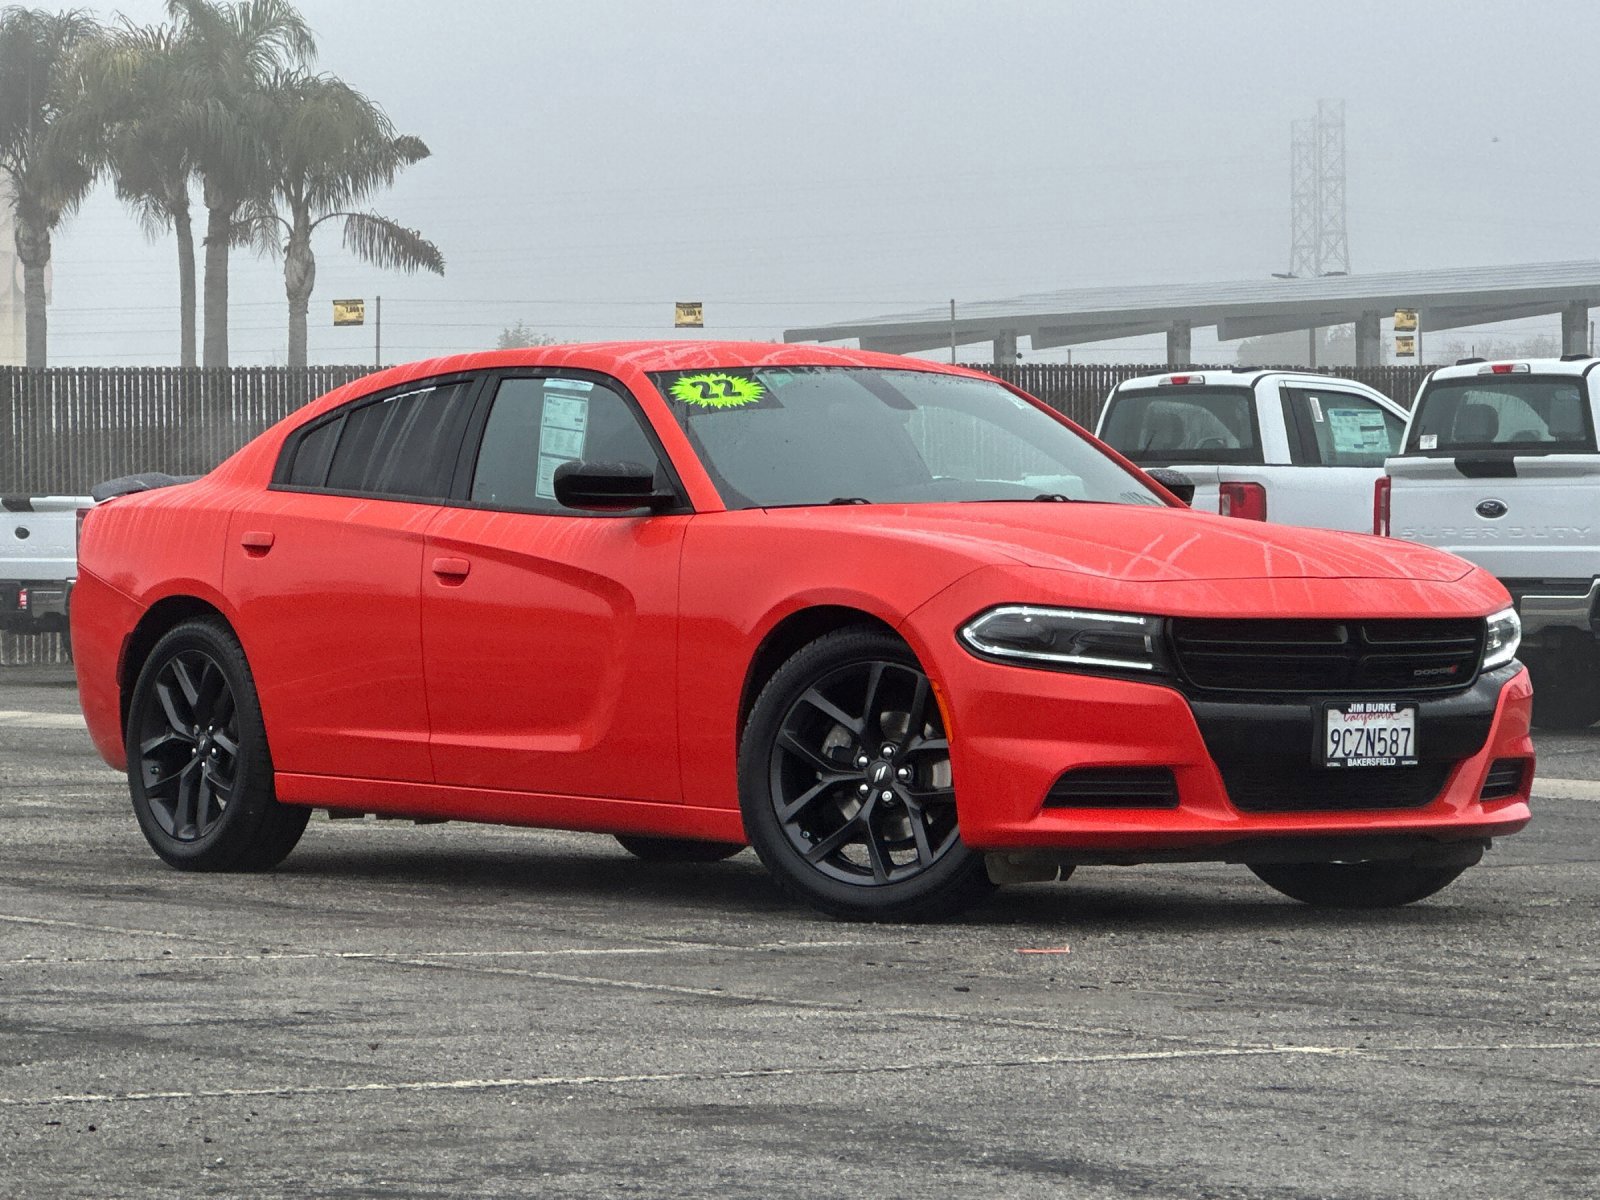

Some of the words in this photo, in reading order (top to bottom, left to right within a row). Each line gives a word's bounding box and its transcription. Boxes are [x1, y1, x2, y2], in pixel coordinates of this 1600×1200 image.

[689, 378, 742, 399] 22
[1401, 526, 1499, 539] SUPER
[1507, 525, 1591, 539] DUTY
[1348, 703, 1364, 713] JIM
[1365, 703, 1397, 713] BURKE
[1329, 727, 1411, 758] 9CZN587
[1347, 757, 1397, 767] BAKERSFIELD
